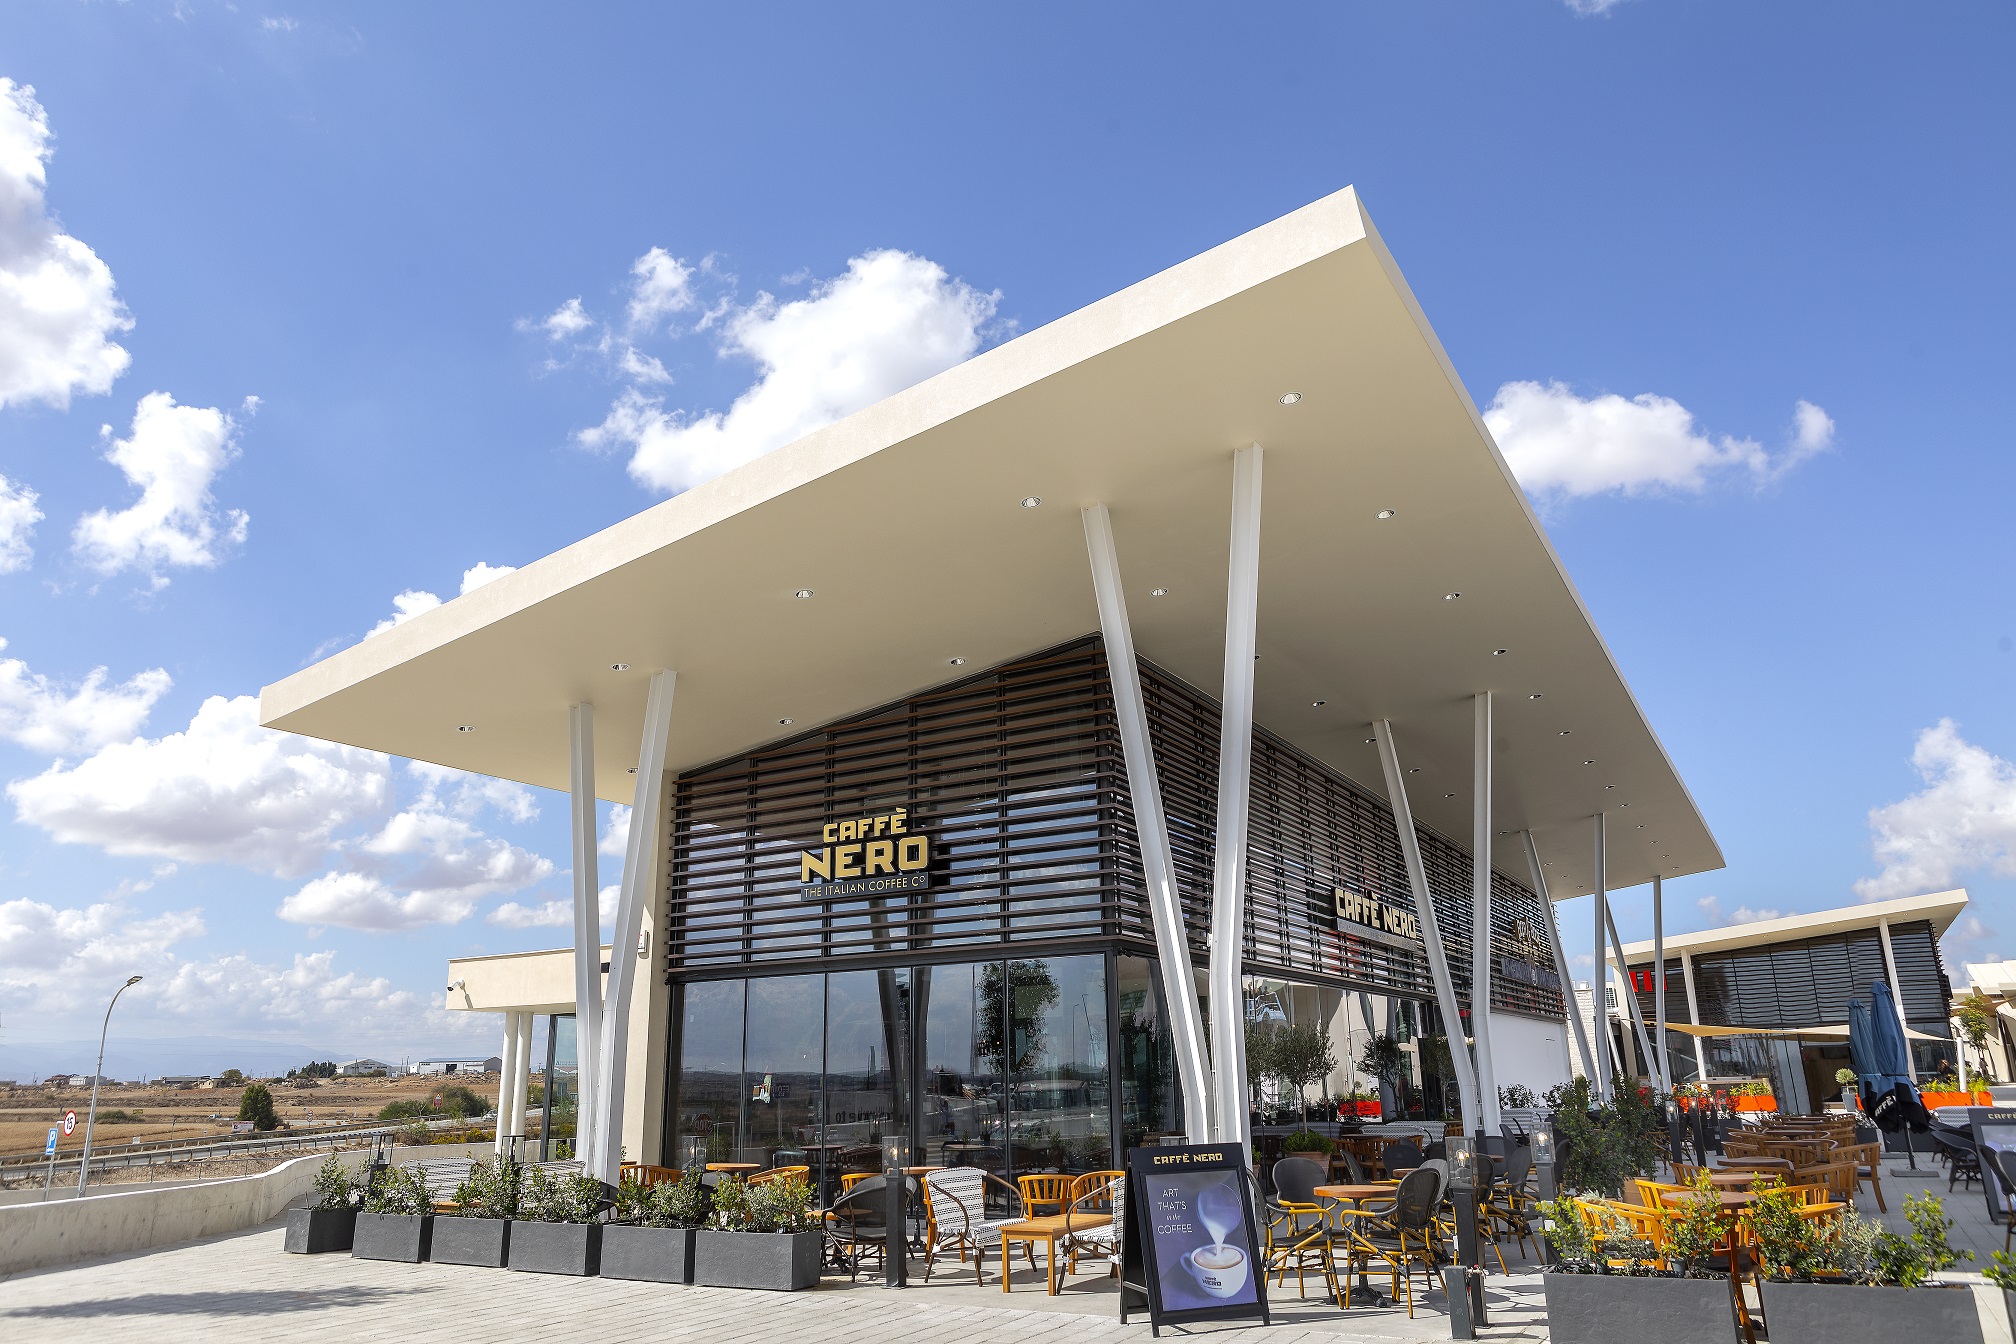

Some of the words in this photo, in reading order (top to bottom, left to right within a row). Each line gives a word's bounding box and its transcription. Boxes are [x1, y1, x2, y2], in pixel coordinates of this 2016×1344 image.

[823, 807, 907, 843] CAFFÈ
[801, 835, 928, 883] NERO
[804, 887, 822, 898] THE
[825, 882, 865, 896] ITALIAN
[868, 877, 908, 891] COFFEE
[1334, 888, 1381, 929] CAFFÈ
[1382, 904, 1417, 939] NERO
[1874, 1095, 1894, 1117] AFFÈ
[66, 1116, 74, 1130] 15
[48, 1130, 56, 1147] P
[1153, 1152, 1190, 1165] CAFFÈ
[1193, 1152, 1223, 1162] NERO
[1162, 1188, 1179, 1198] ART
[1157, 1200, 1187, 1211] THAT'S
[1157, 1223, 1193, 1235] COFFEE
